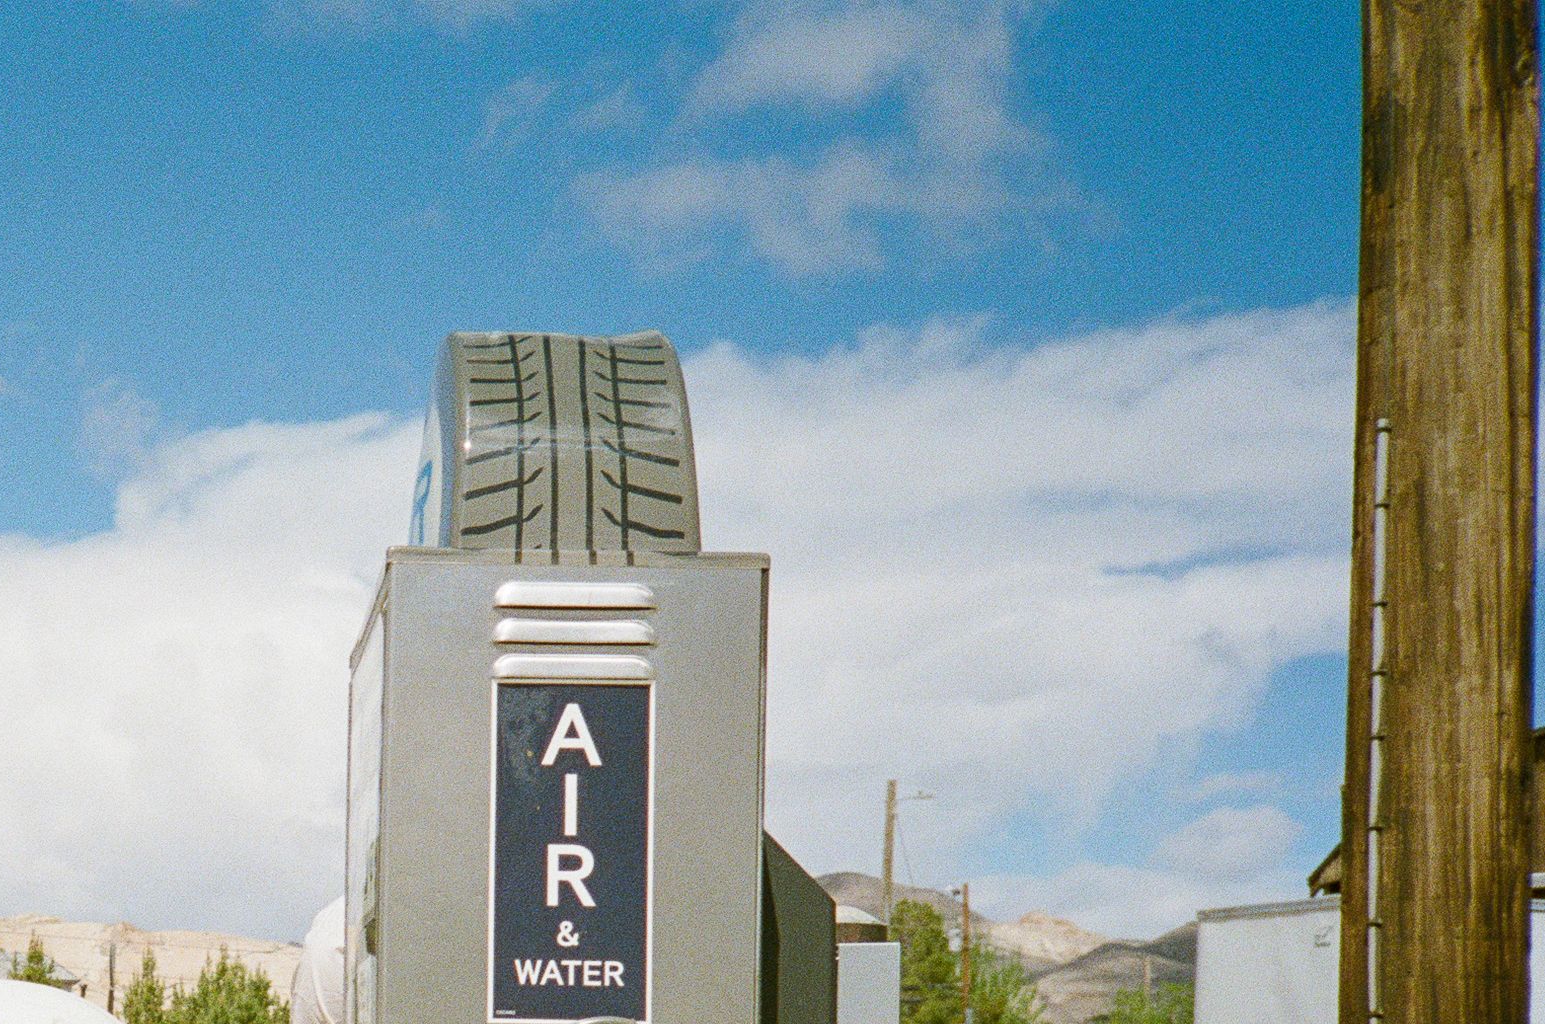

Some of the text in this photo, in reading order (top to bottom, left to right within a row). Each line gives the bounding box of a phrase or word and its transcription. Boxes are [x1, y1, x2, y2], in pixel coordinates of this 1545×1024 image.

[541, 702, 602, 908] AIR
[557, 920, 579, 947] &
[514, 959, 625, 988] WATER
